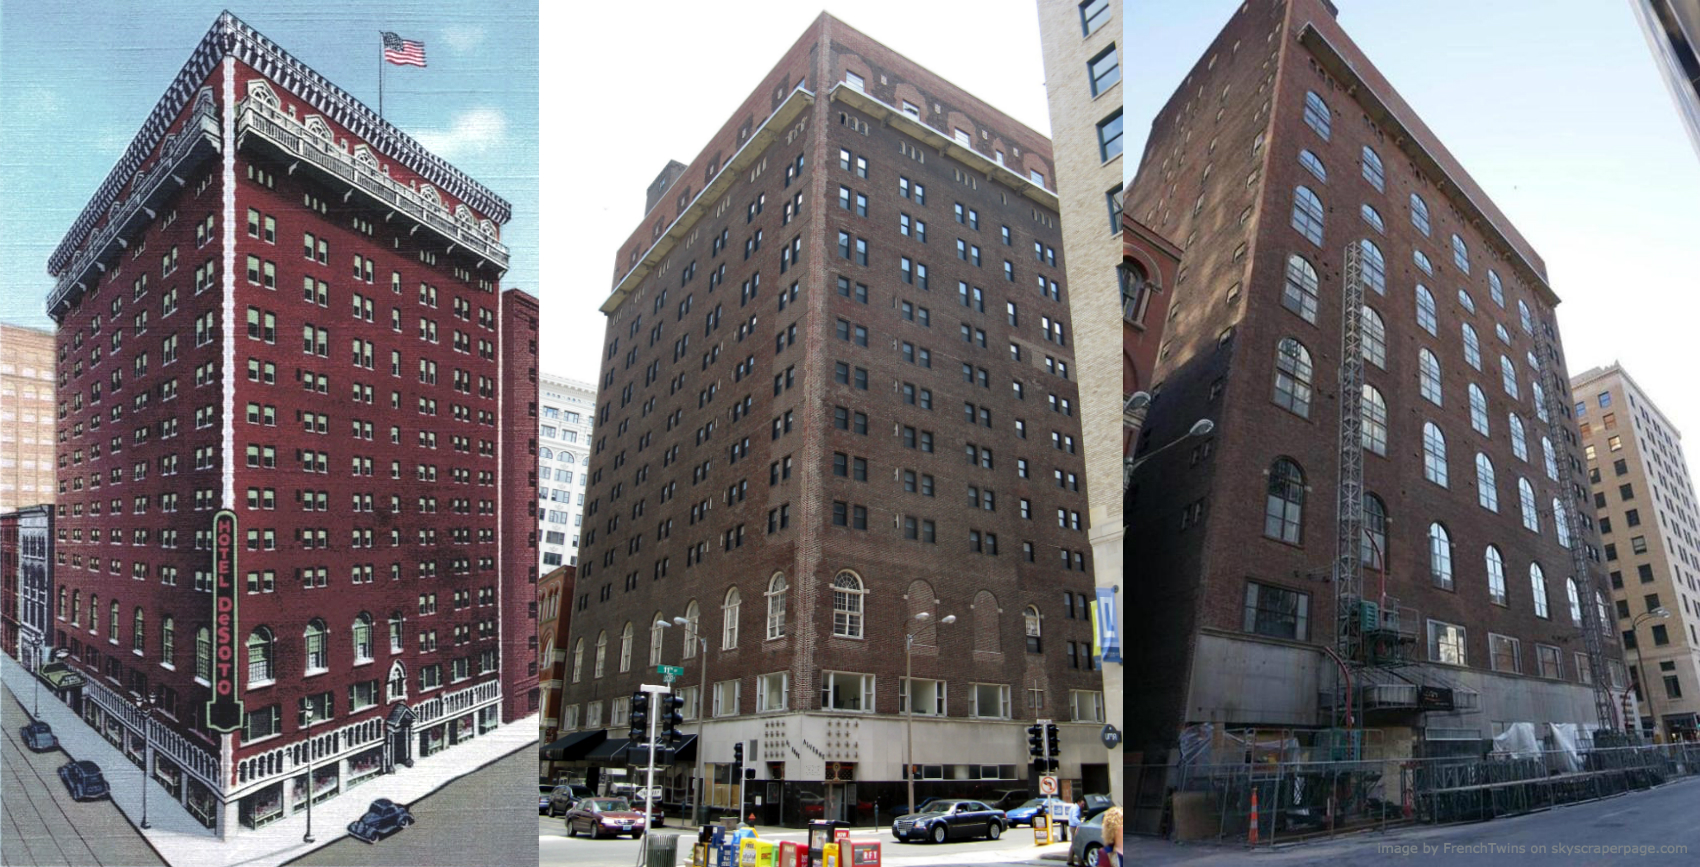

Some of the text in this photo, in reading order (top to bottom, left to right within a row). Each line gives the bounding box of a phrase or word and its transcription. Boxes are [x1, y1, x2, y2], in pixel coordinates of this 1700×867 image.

[217, 520, 233, 695] HOTEL DeSOTO
[863, 850, 878, 860] RFT
